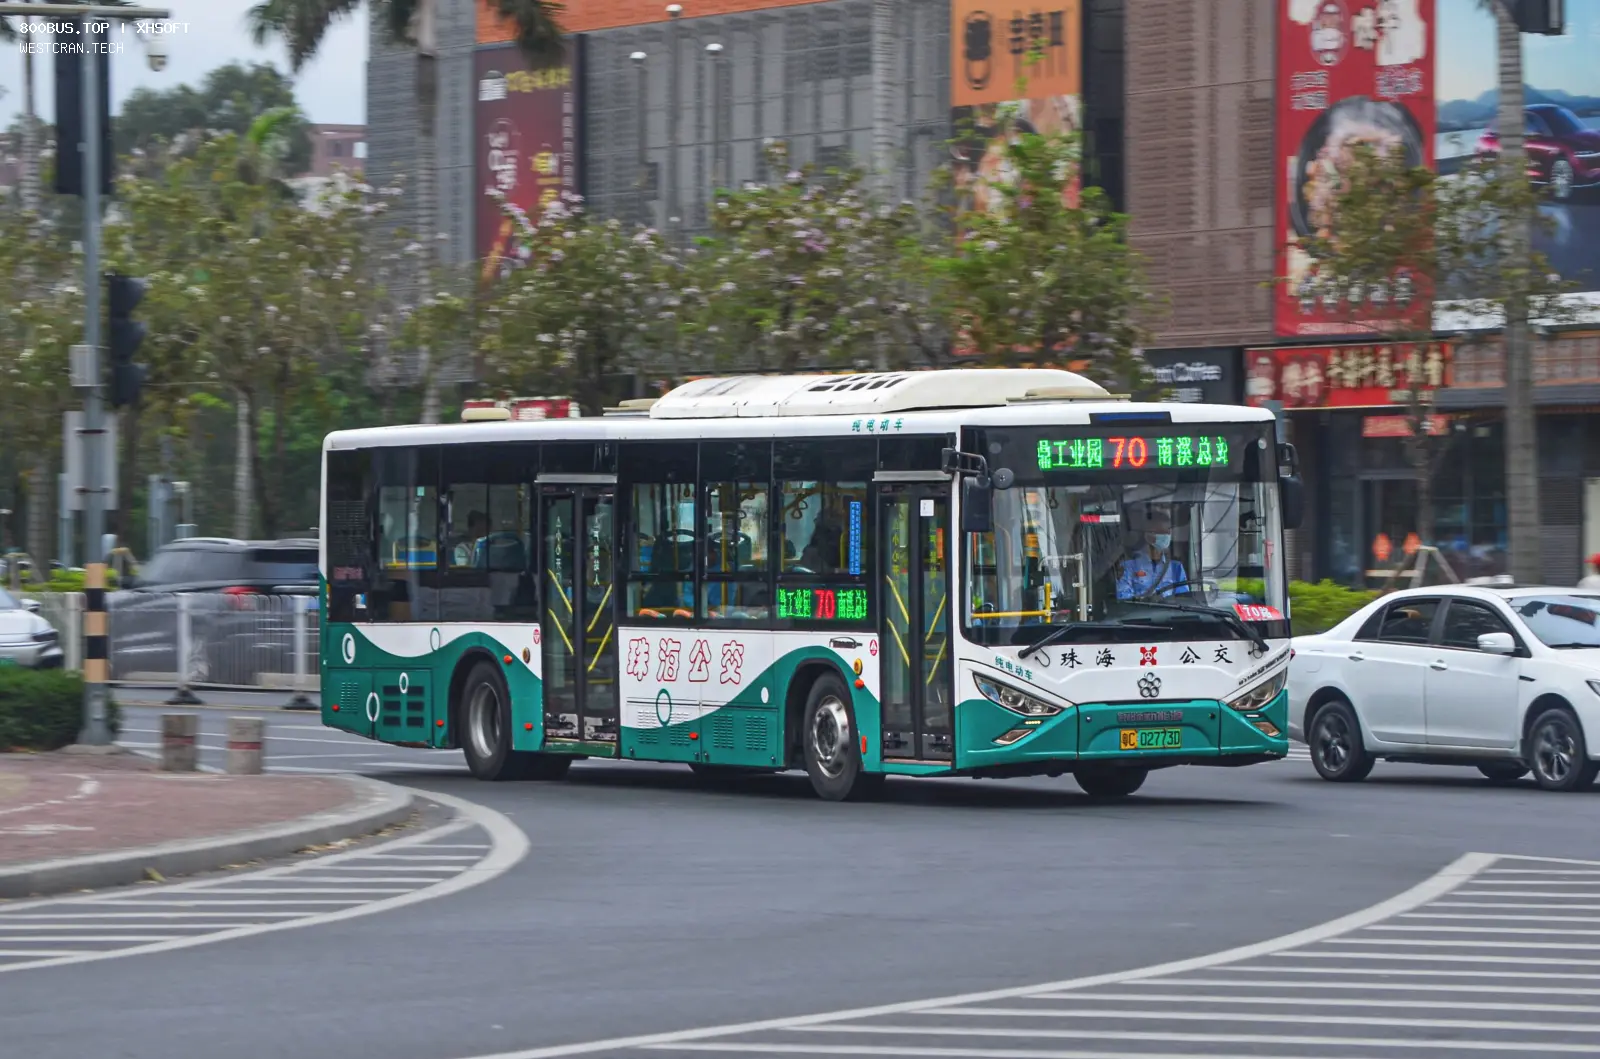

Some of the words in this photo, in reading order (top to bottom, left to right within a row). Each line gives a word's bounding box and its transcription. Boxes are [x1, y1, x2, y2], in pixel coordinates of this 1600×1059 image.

[1108, 437, 1148, 468] 70
[814, 589, 836, 619] 70
[627, 637, 744, 685] 珠海公交
[995, 656, 1033, 680] 纯电动车
[1060, 648, 1116, 669] 珠海
[1179, 644, 1233, 664] 公交
